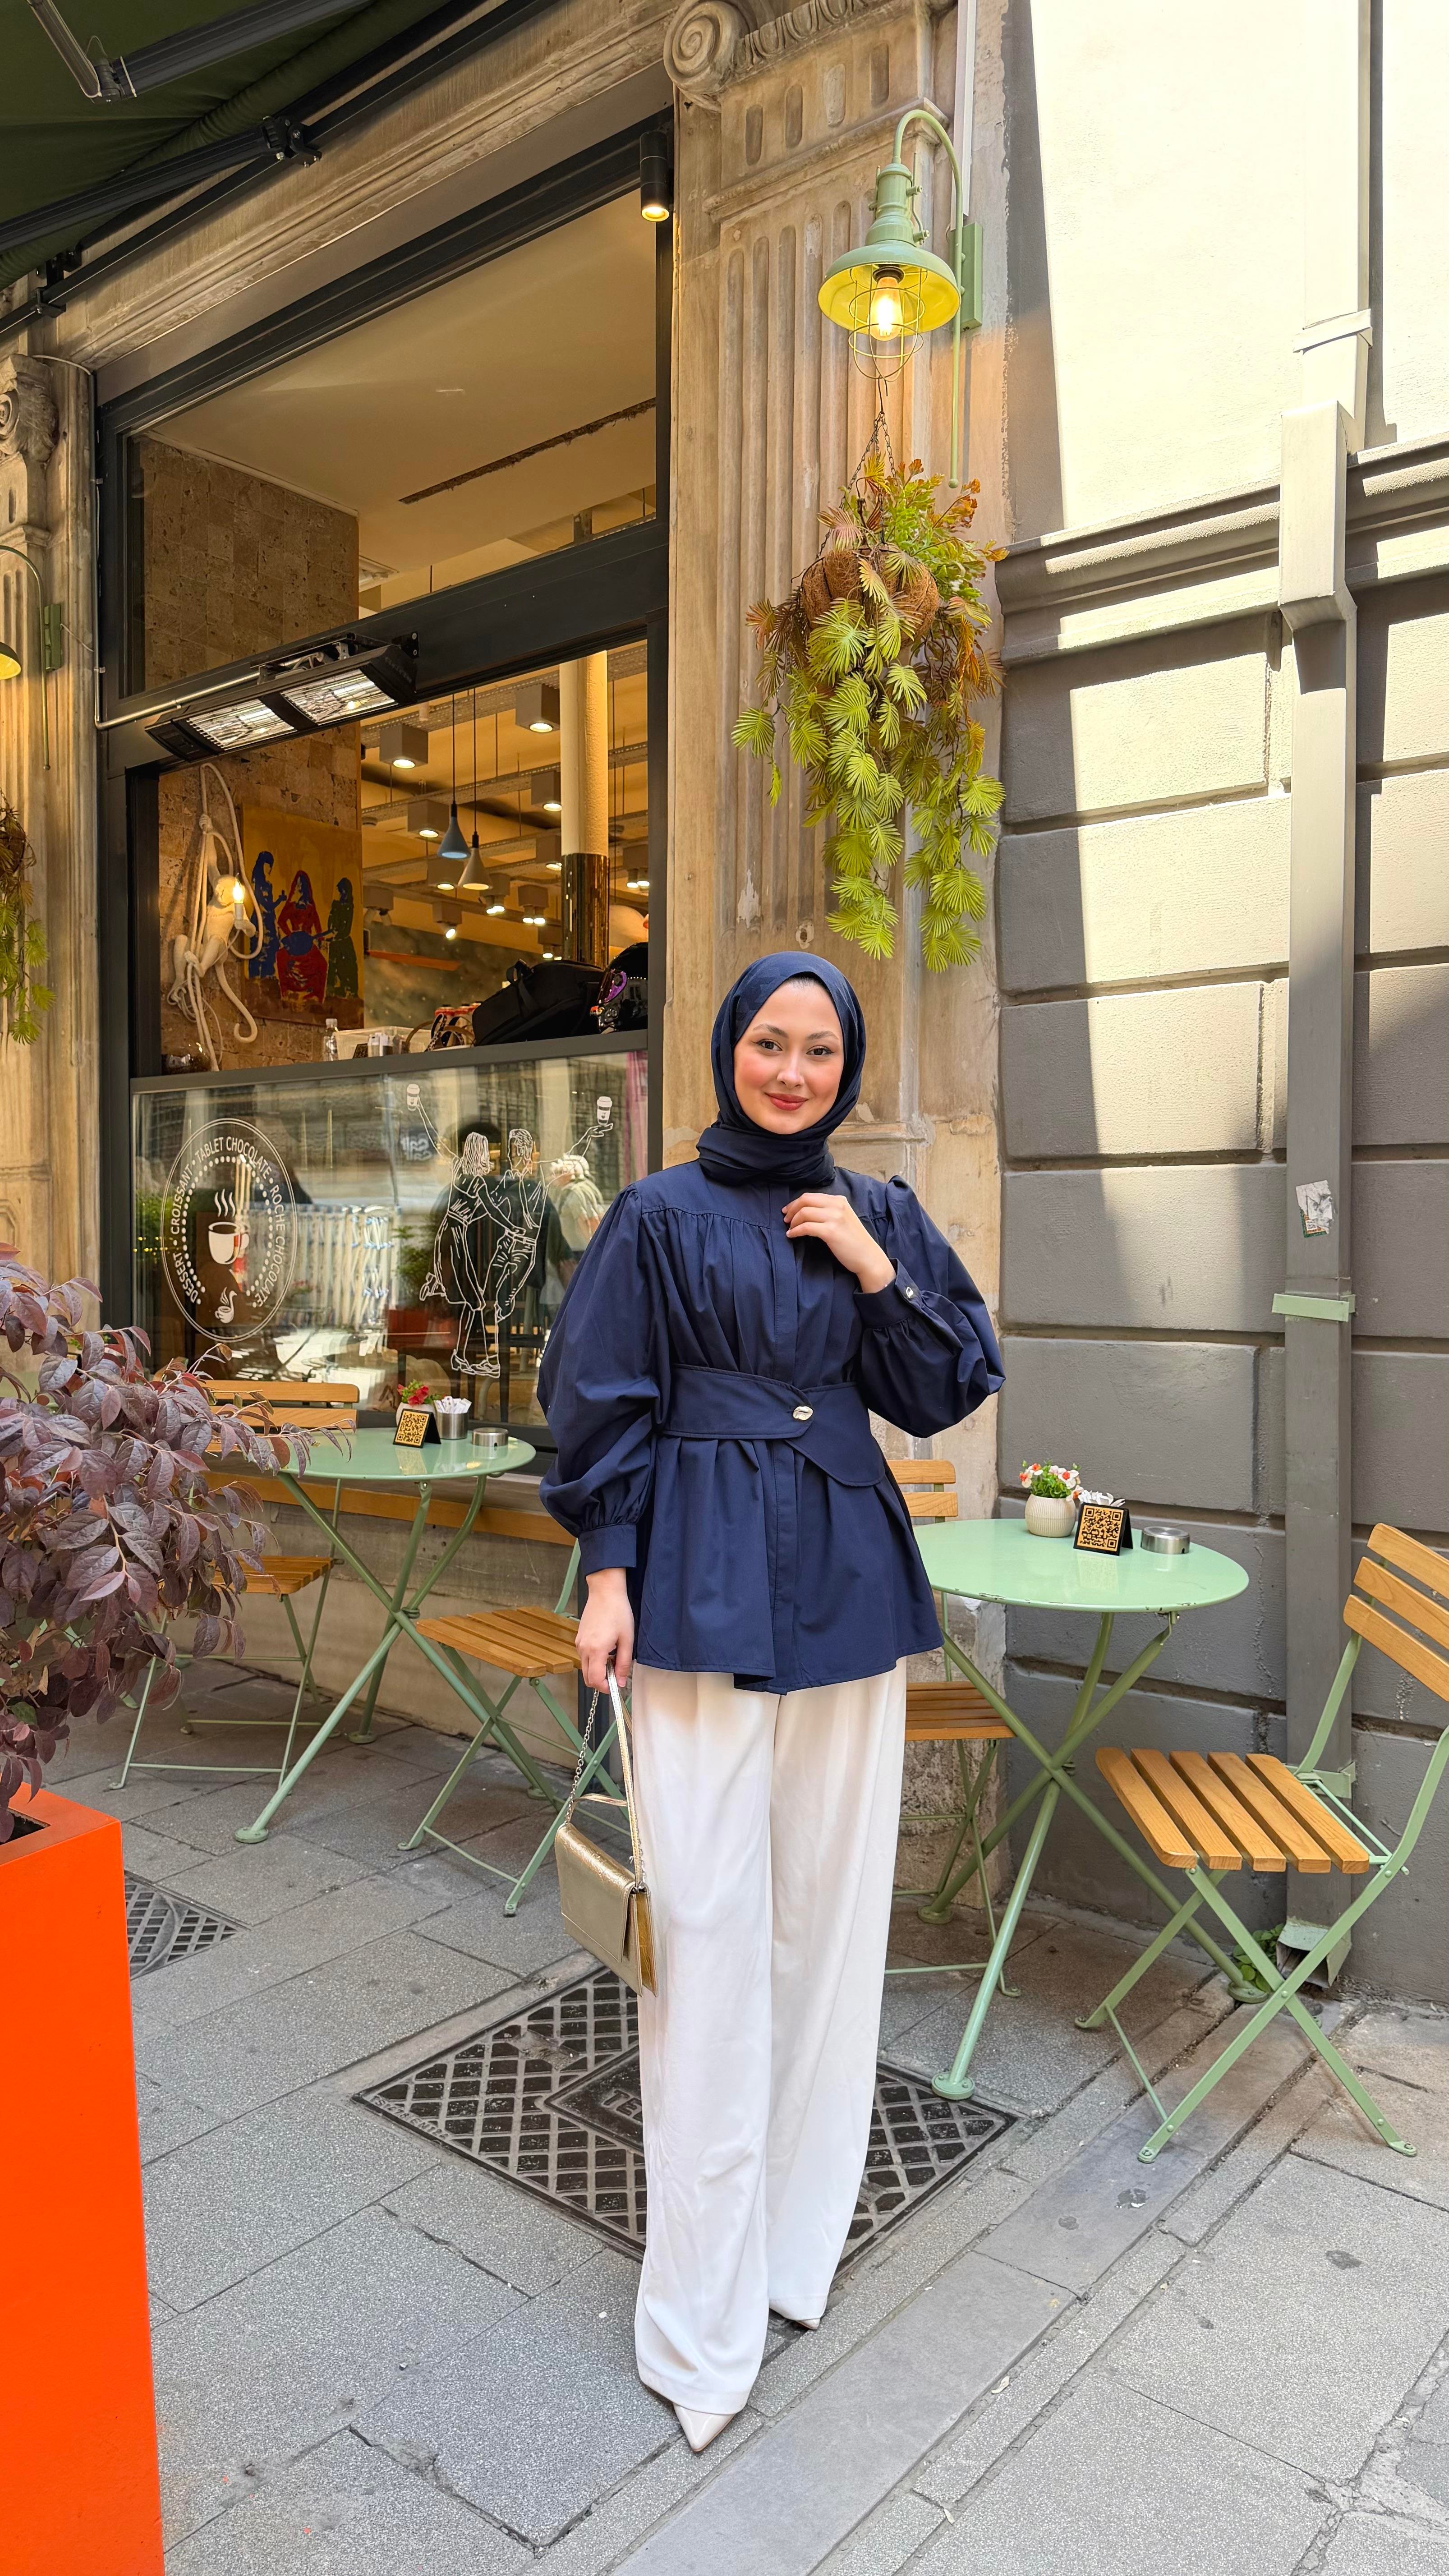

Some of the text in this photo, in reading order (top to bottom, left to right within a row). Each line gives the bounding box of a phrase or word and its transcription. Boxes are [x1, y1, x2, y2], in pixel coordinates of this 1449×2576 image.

[170, 1136, 286, 1307] DESSERT CROISSANT TABLET CHOCOLATE ROCHE CHOCOLATE
